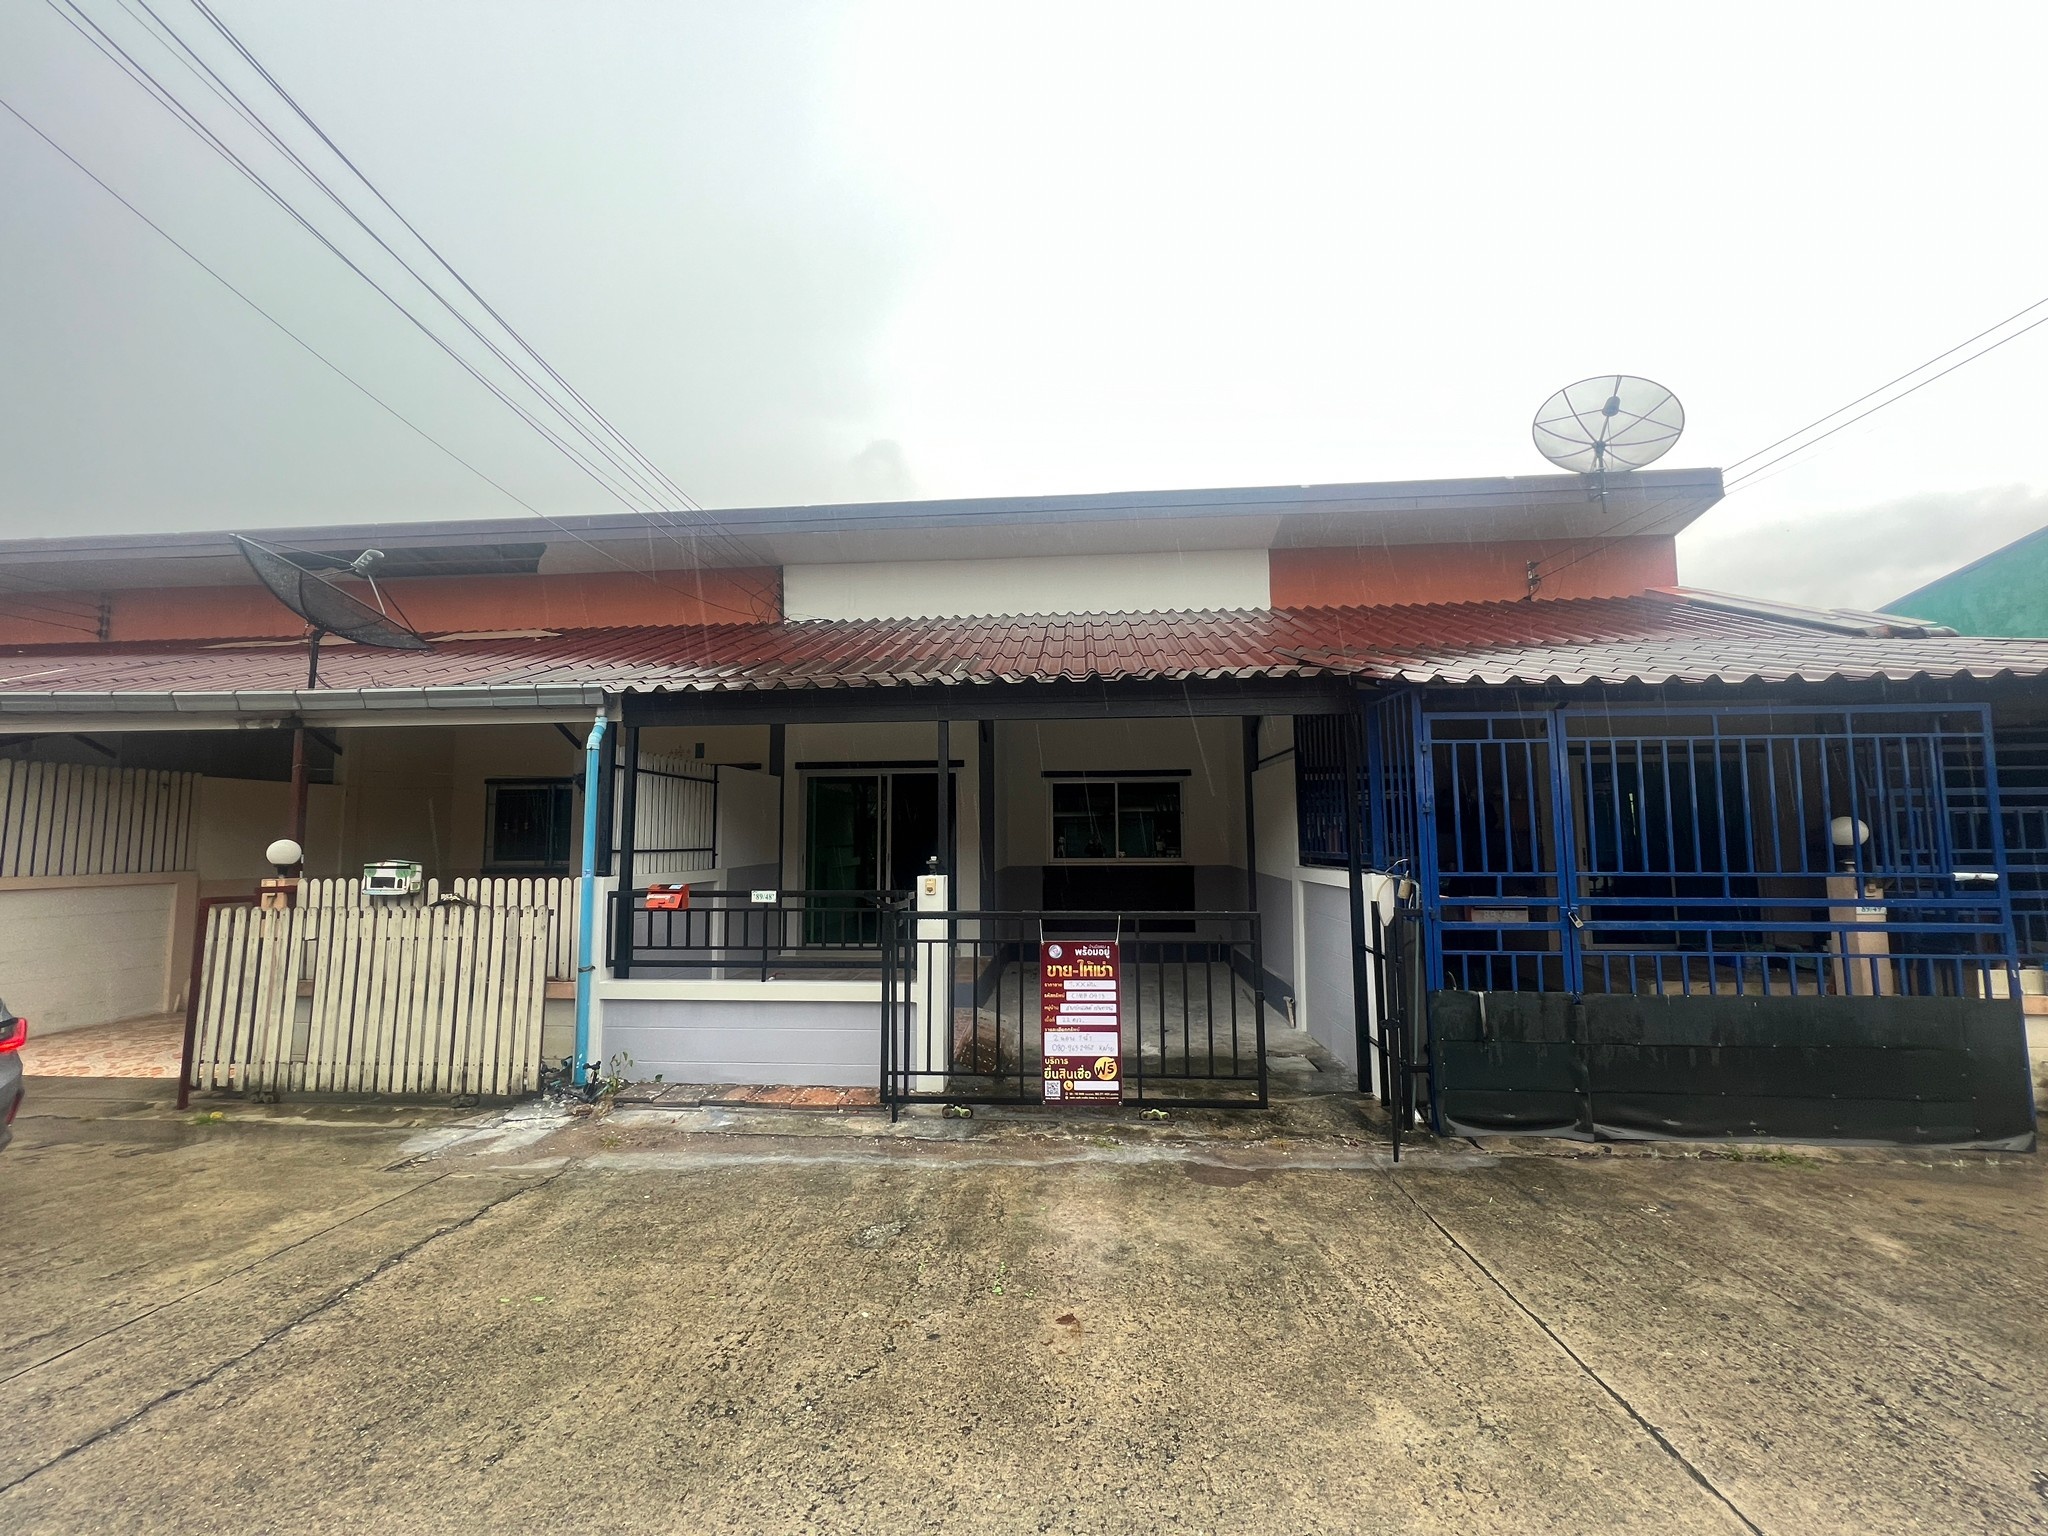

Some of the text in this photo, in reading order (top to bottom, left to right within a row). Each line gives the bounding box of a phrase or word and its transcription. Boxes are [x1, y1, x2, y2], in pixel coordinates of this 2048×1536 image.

[1075, 945, 1110, 958] พร้อมอยู่
[1047, 959, 1113, 977] ขาย-ให้เช่า
[1044, 1056, 1069, 1064] บริการ
[1096, 1059, 1115, 1075] ฟรี
[1044, 1065, 1092, 1079] ยื่นสินเชื่อ
